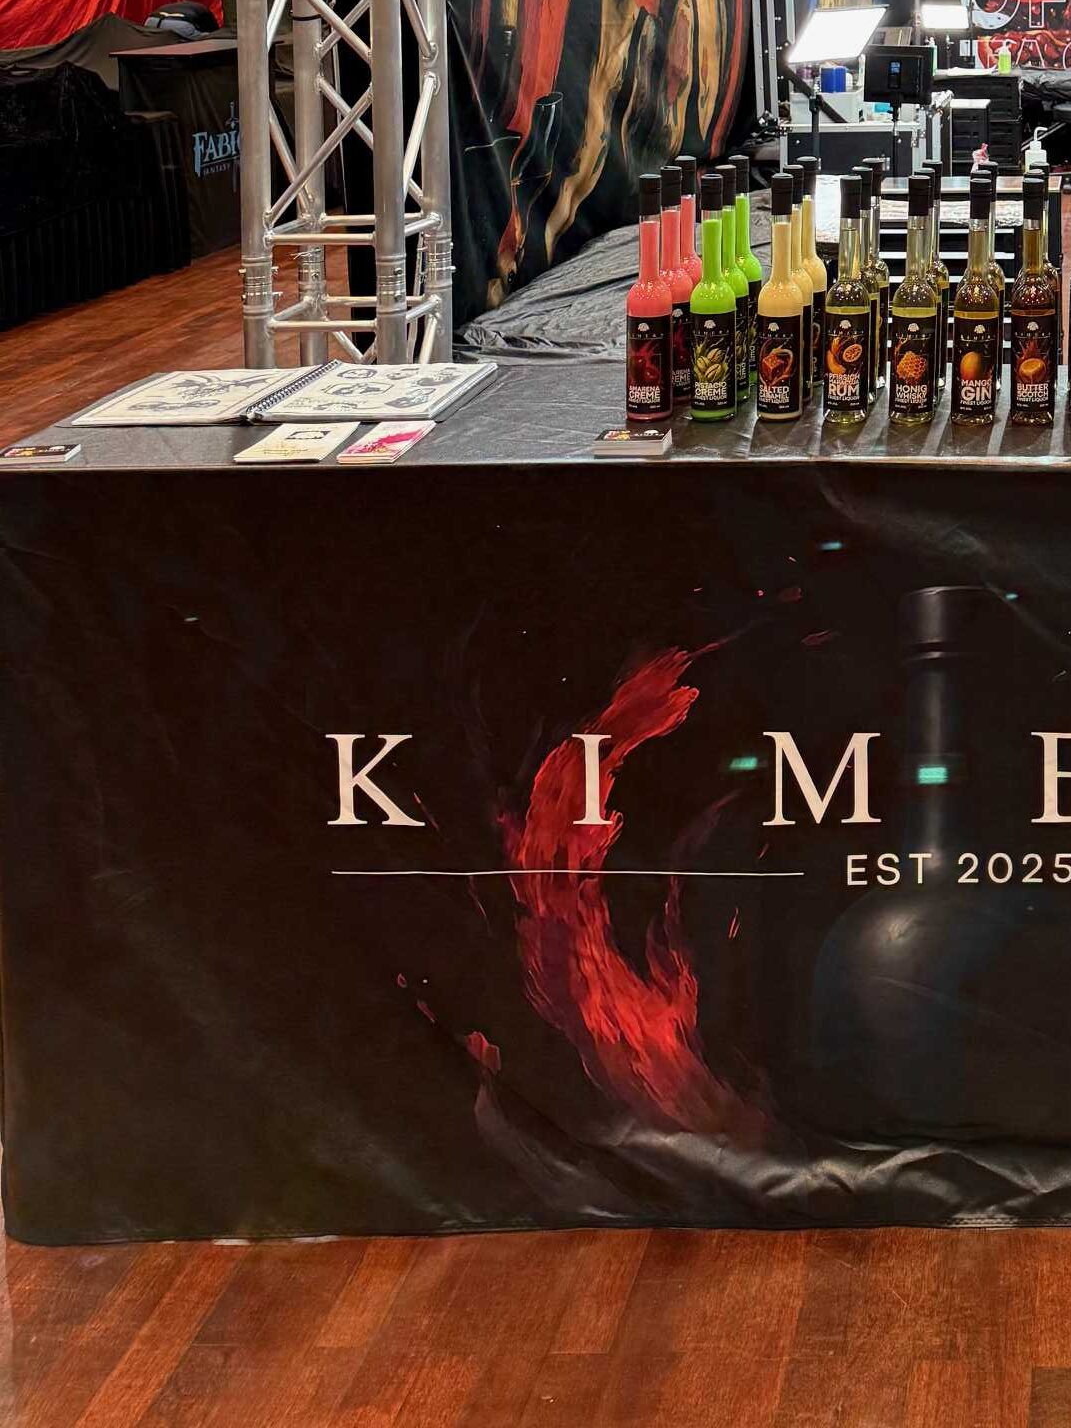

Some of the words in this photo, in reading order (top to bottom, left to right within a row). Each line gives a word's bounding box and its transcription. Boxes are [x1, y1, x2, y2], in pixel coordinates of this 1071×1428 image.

[192, 131, 240, 177] FABI
[694, 388, 727, 396] CREME
[759, 385, 790, 393] SALTED
[828, 385, 860, 396] RUM
[896, 384, 928, 393] HONIG
[628, 390, 661, 399] CREME
[961, 387, 992, 401] GIN
[847, 852, 933, 886] EST
